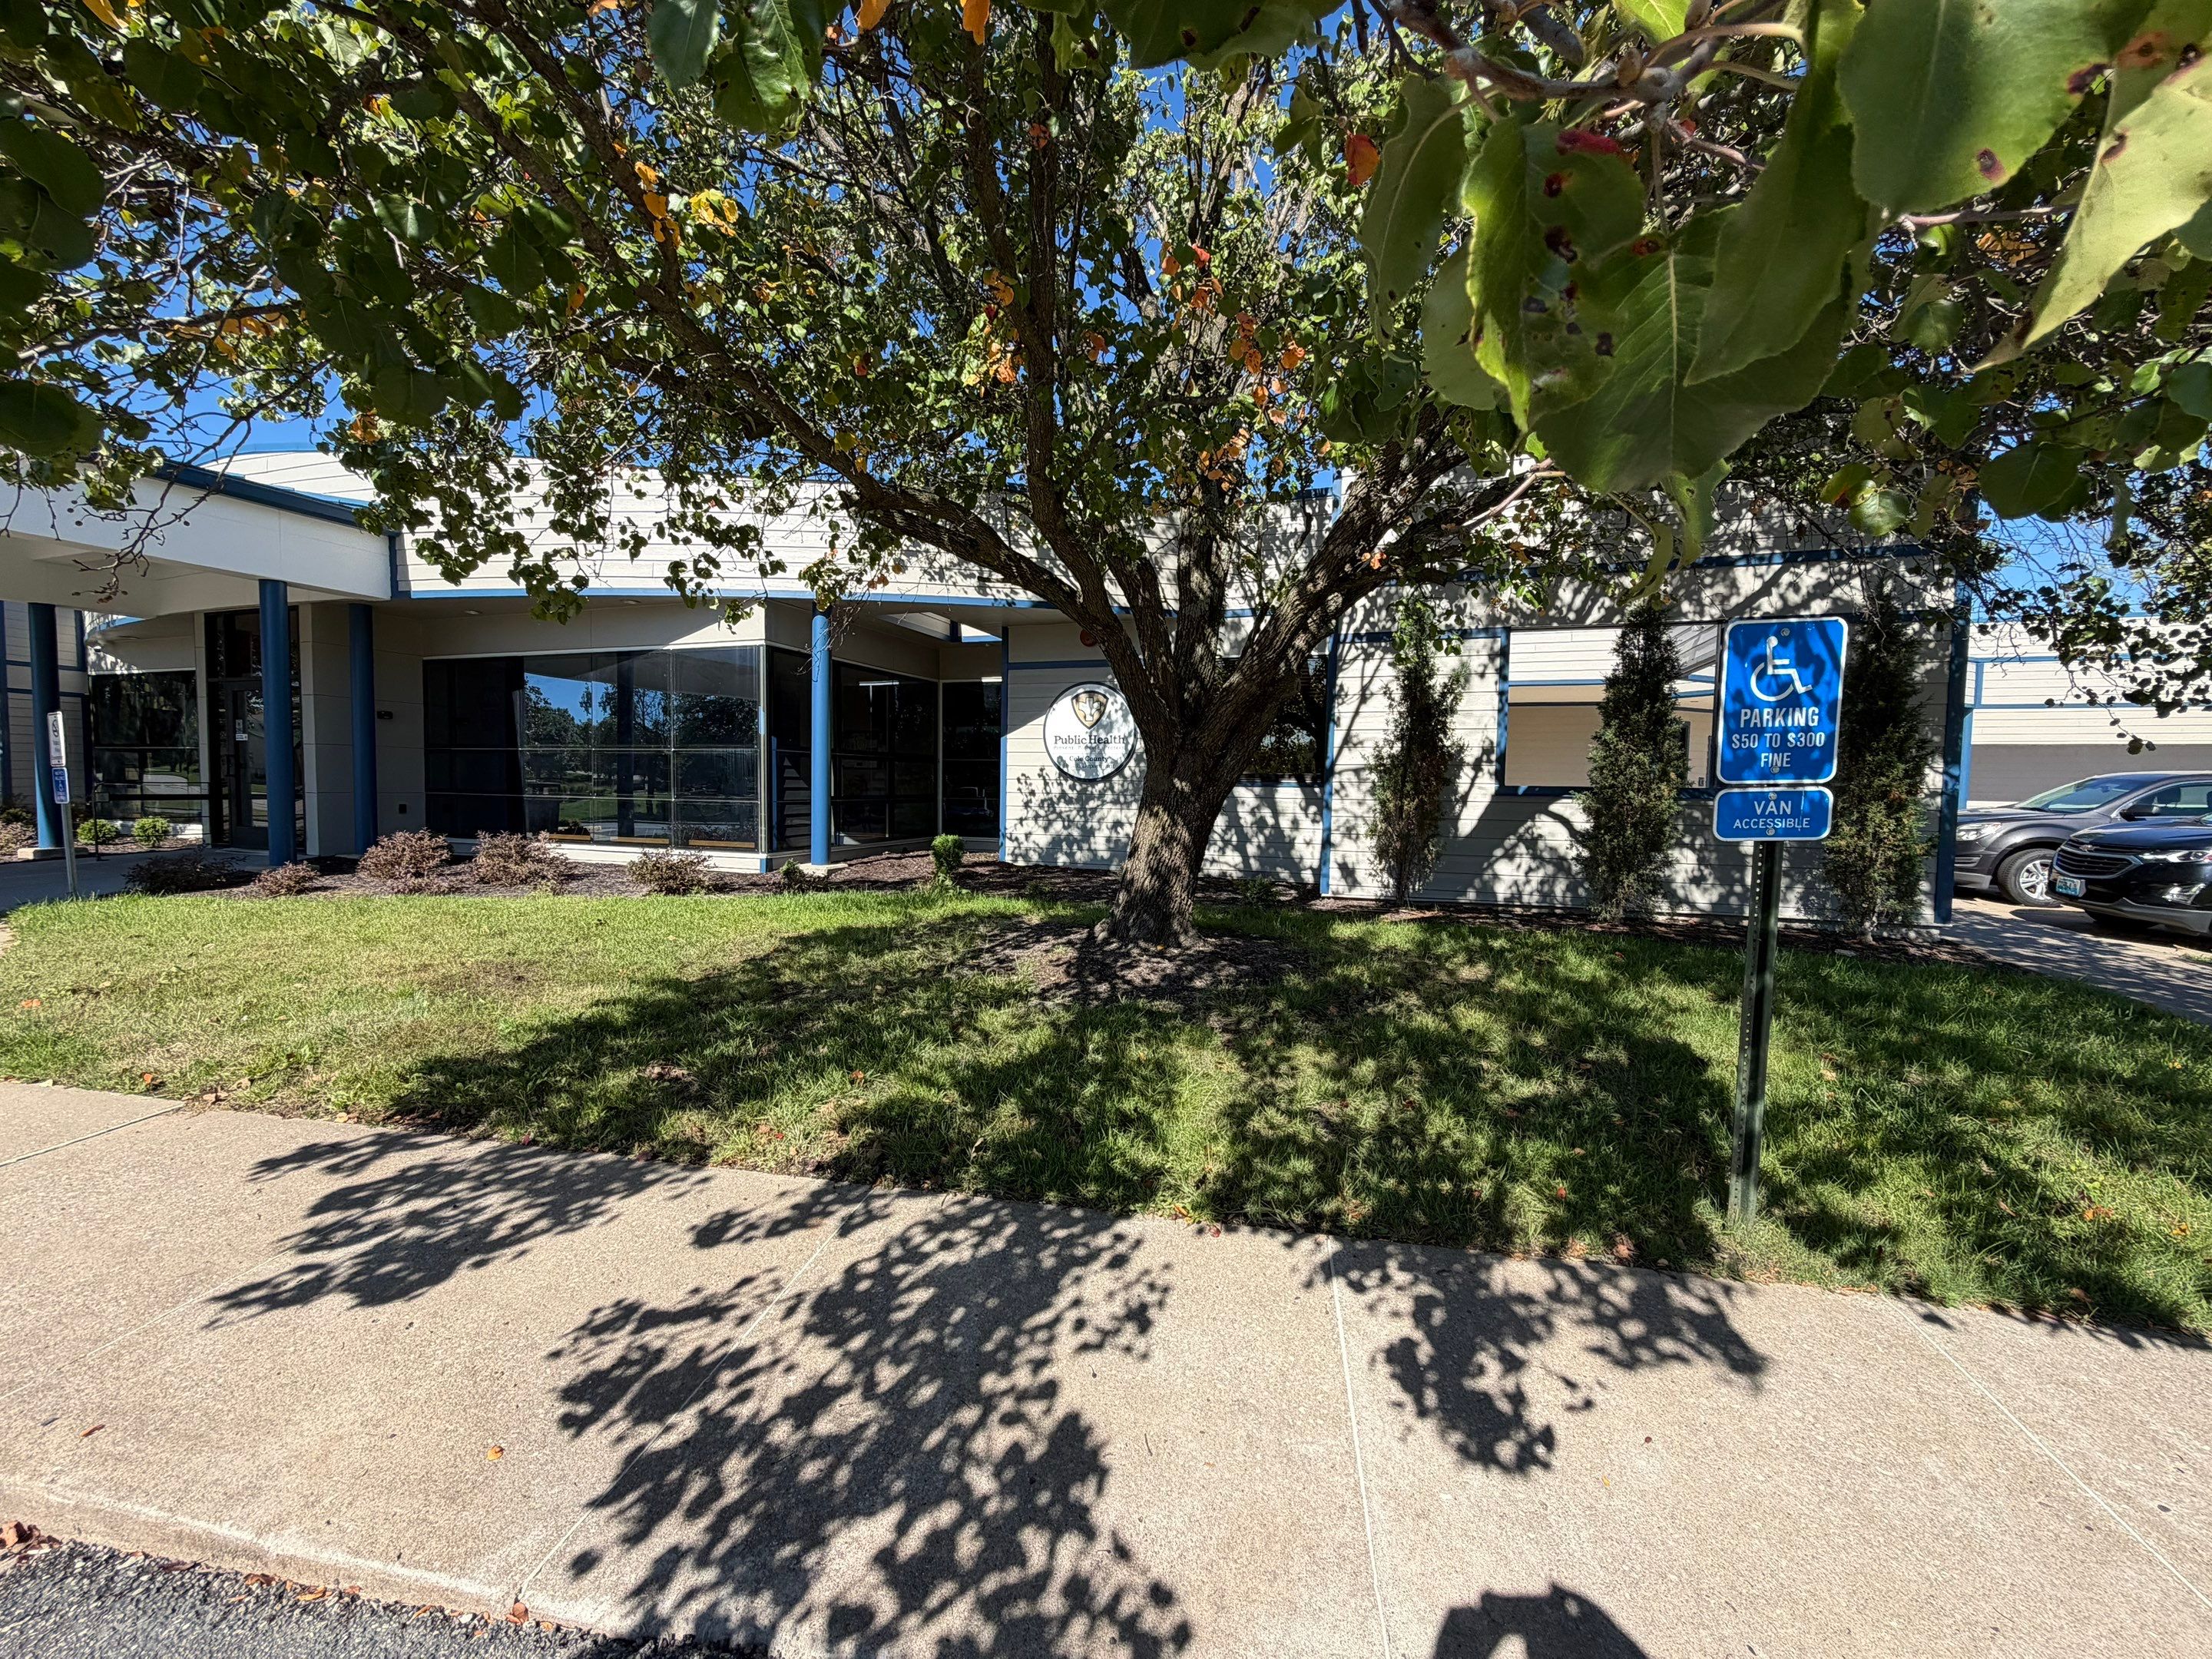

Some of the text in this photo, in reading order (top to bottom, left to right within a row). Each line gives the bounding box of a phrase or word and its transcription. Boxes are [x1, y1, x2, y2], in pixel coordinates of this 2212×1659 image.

[1740, 707, 1819, 727] PARKING
[1054, 735, 1126, 744] Public Health
[1764, 733, 1781, 748] TO
[1760, 753, 1791, 767] FINE
[1754, 800, 1792, 815] VAN
[1733, 818, 1811, 829] ACCESSIBLE
